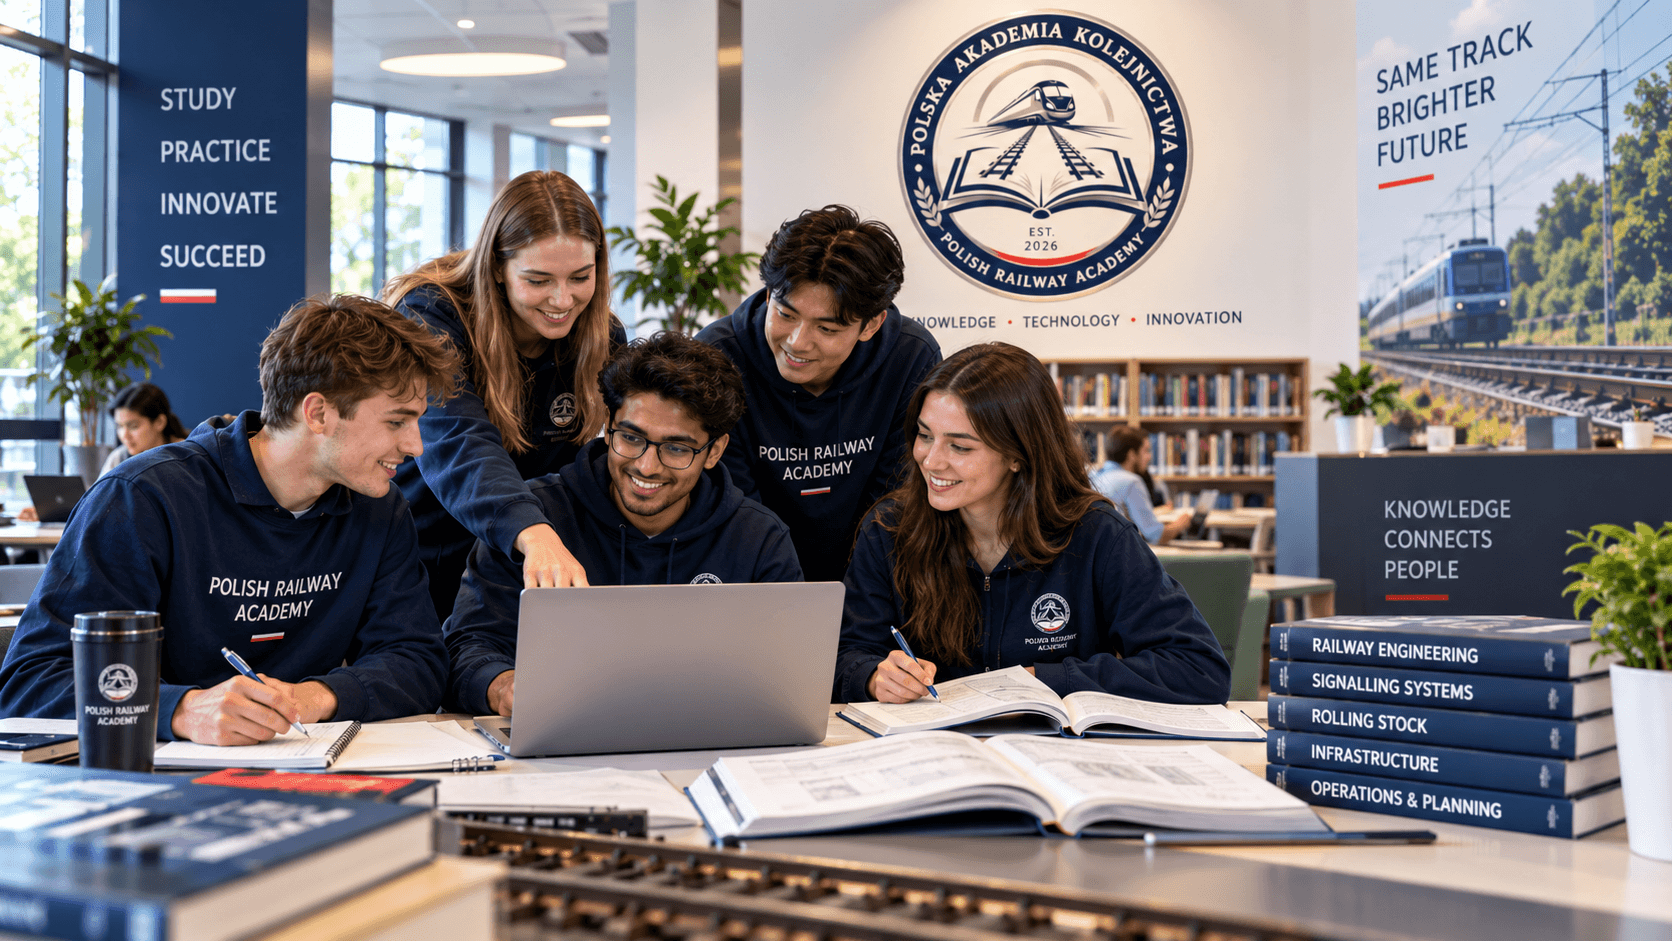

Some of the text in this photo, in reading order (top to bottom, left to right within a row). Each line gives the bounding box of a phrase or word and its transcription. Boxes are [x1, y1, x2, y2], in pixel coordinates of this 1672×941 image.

[1376, 20, 1534, 95] SAME TRACK
[160, 87, 237, 111] STUDY
[910, 22, 1179, 157] POLSKA AKADEMIA KOLEJNICTWA
[1377, 75, 1496, 131] BRIGHTER
[160, 139, 271, 163] PRACTICE
[1377, 122, 1469, 167] FUTURE
[160, 191, 278, 215] INNOVATE
[1028, 226, 1056, 238] EST.
[159, 244, 266, 268] SUCCEED
[1024, 240, 1059, 252] 2026
[940, 231, 1146, 289] POLISH RAILWAY ACADEMY
[911, 310, 1243, 329] NOWLEDGE TECHNOLOGY INNOVATION
[759, 435, 876, 462] POLISH RAILWAY
[782, 459, 854, 481] ACADEMY
[1384, 499, 1511, 519] KNOWLEDGE
[1384, 529, 1493, 549] CONNECTS
[1384, 560, 1459, 579] PEOPLE
[208, 571, 343, 598] POLISH RAILWAY
[234, 599, 314, 622] ACADEMY
[1312, 637, 1374, 657] RAILWAY
[1378, 641, 1479, 664] ENGINEERING
[1312, 672, 1400, 695] SIGNALLING
[1404, 680, 1474, 701] SYSTEMS
[1311, 708, 1428, 734] ROLLING STOCK
[1311, 744, 1439, 773] INFRASTRUCTURE
[1310, 780, 1403, 806] OPERATIONS
[1406, 792, 1418, 809] &
[1422, 793, 1502, 819] PLANNING
